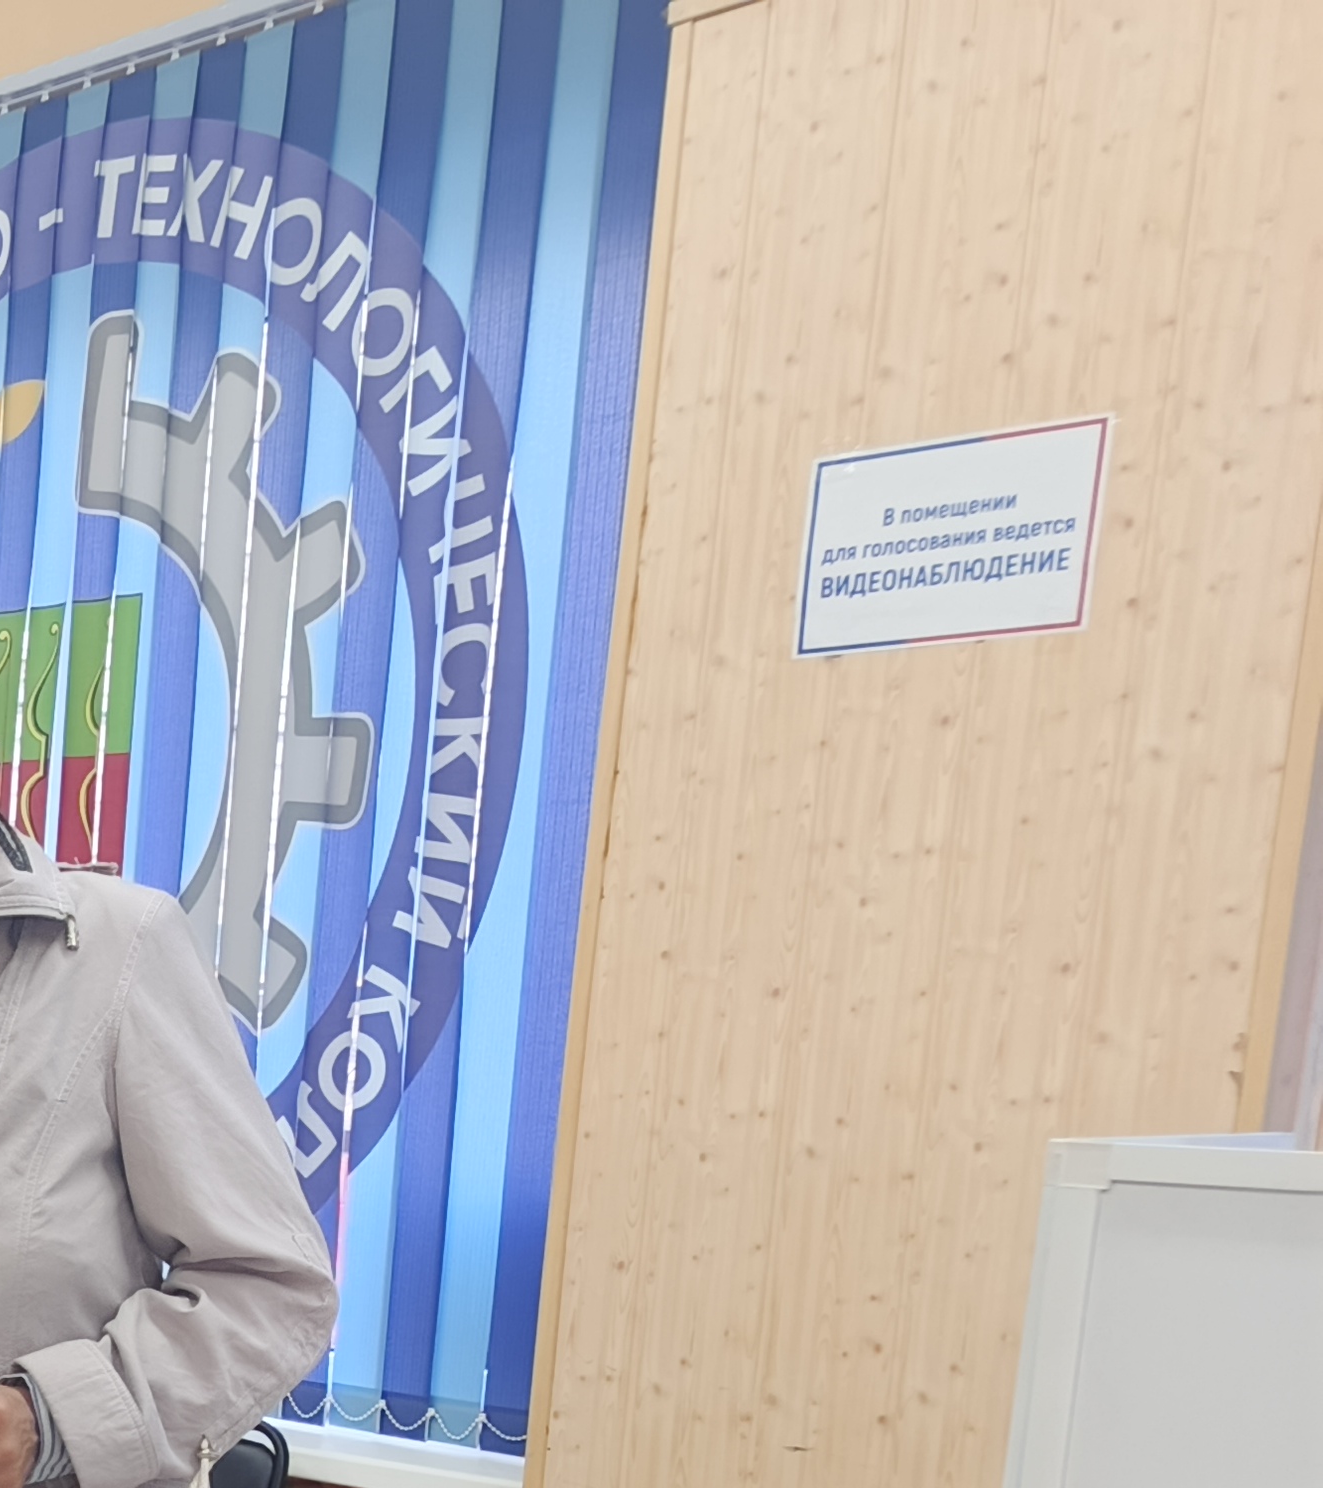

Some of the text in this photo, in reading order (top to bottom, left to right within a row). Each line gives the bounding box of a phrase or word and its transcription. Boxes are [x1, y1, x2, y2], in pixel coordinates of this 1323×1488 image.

[883, 494, 1018, 527] В помещении
[94, 153, 497, 948] ТЕХНОЛОГИЧЕСКИЙ
[821, 517, 1077, 567] для голосования ведется
[820, 548, 1072, 599] ВИДЕОНАБЛЮДЕНИЕ
